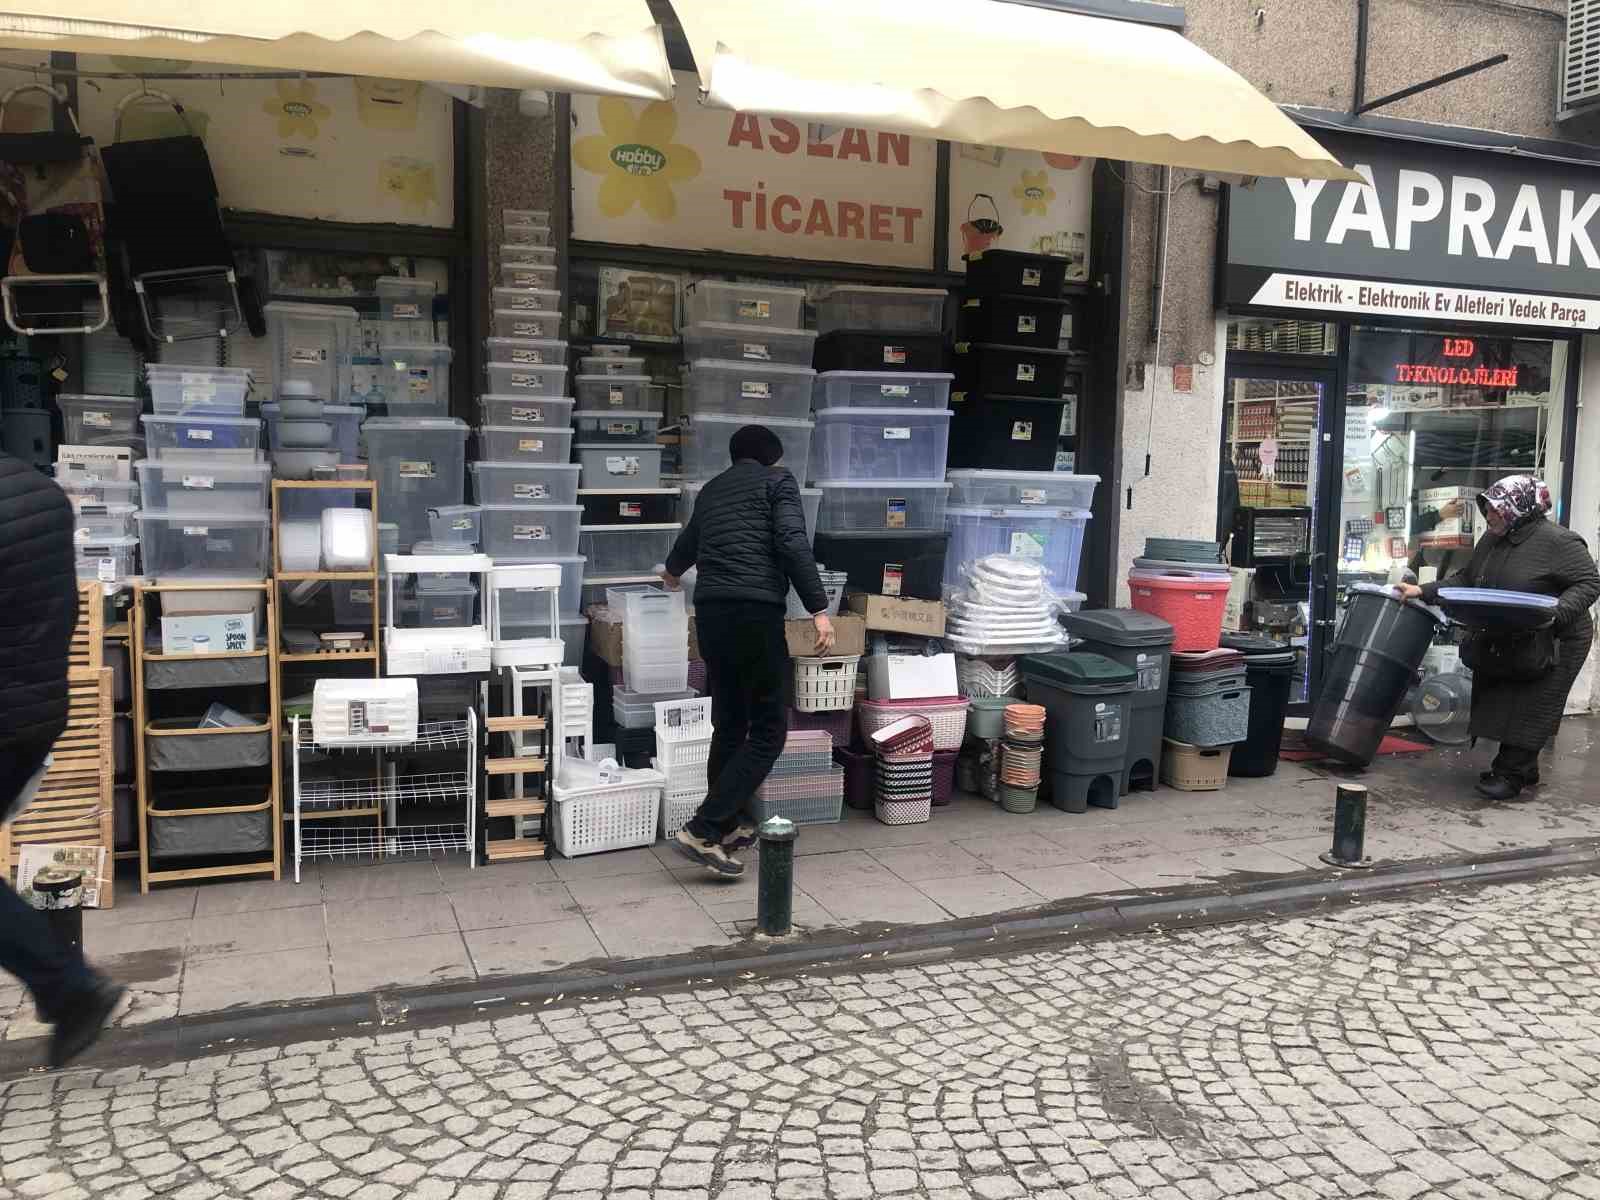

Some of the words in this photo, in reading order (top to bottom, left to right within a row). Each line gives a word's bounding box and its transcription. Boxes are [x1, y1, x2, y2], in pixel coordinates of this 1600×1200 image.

[728, 110, 911, 167] ASLAN
[723, 181, 922, 243] TİCARET
[1285, 164, 1600, 269] YAPRAK
[1285, 280, 1343, 304] Elektrik
[1358, 286, 1431, 311] Elektronik
[1434, 292, 1451, 313] Ev
[1455, 294, 1505, 316] Aletleri
[1508, 298, 1547, 320] Yedek
[1550, 302, 1587, 326] Parça
[1443, 338, 1474, 357] LED
[224, 631, 247, 641] SPOON
